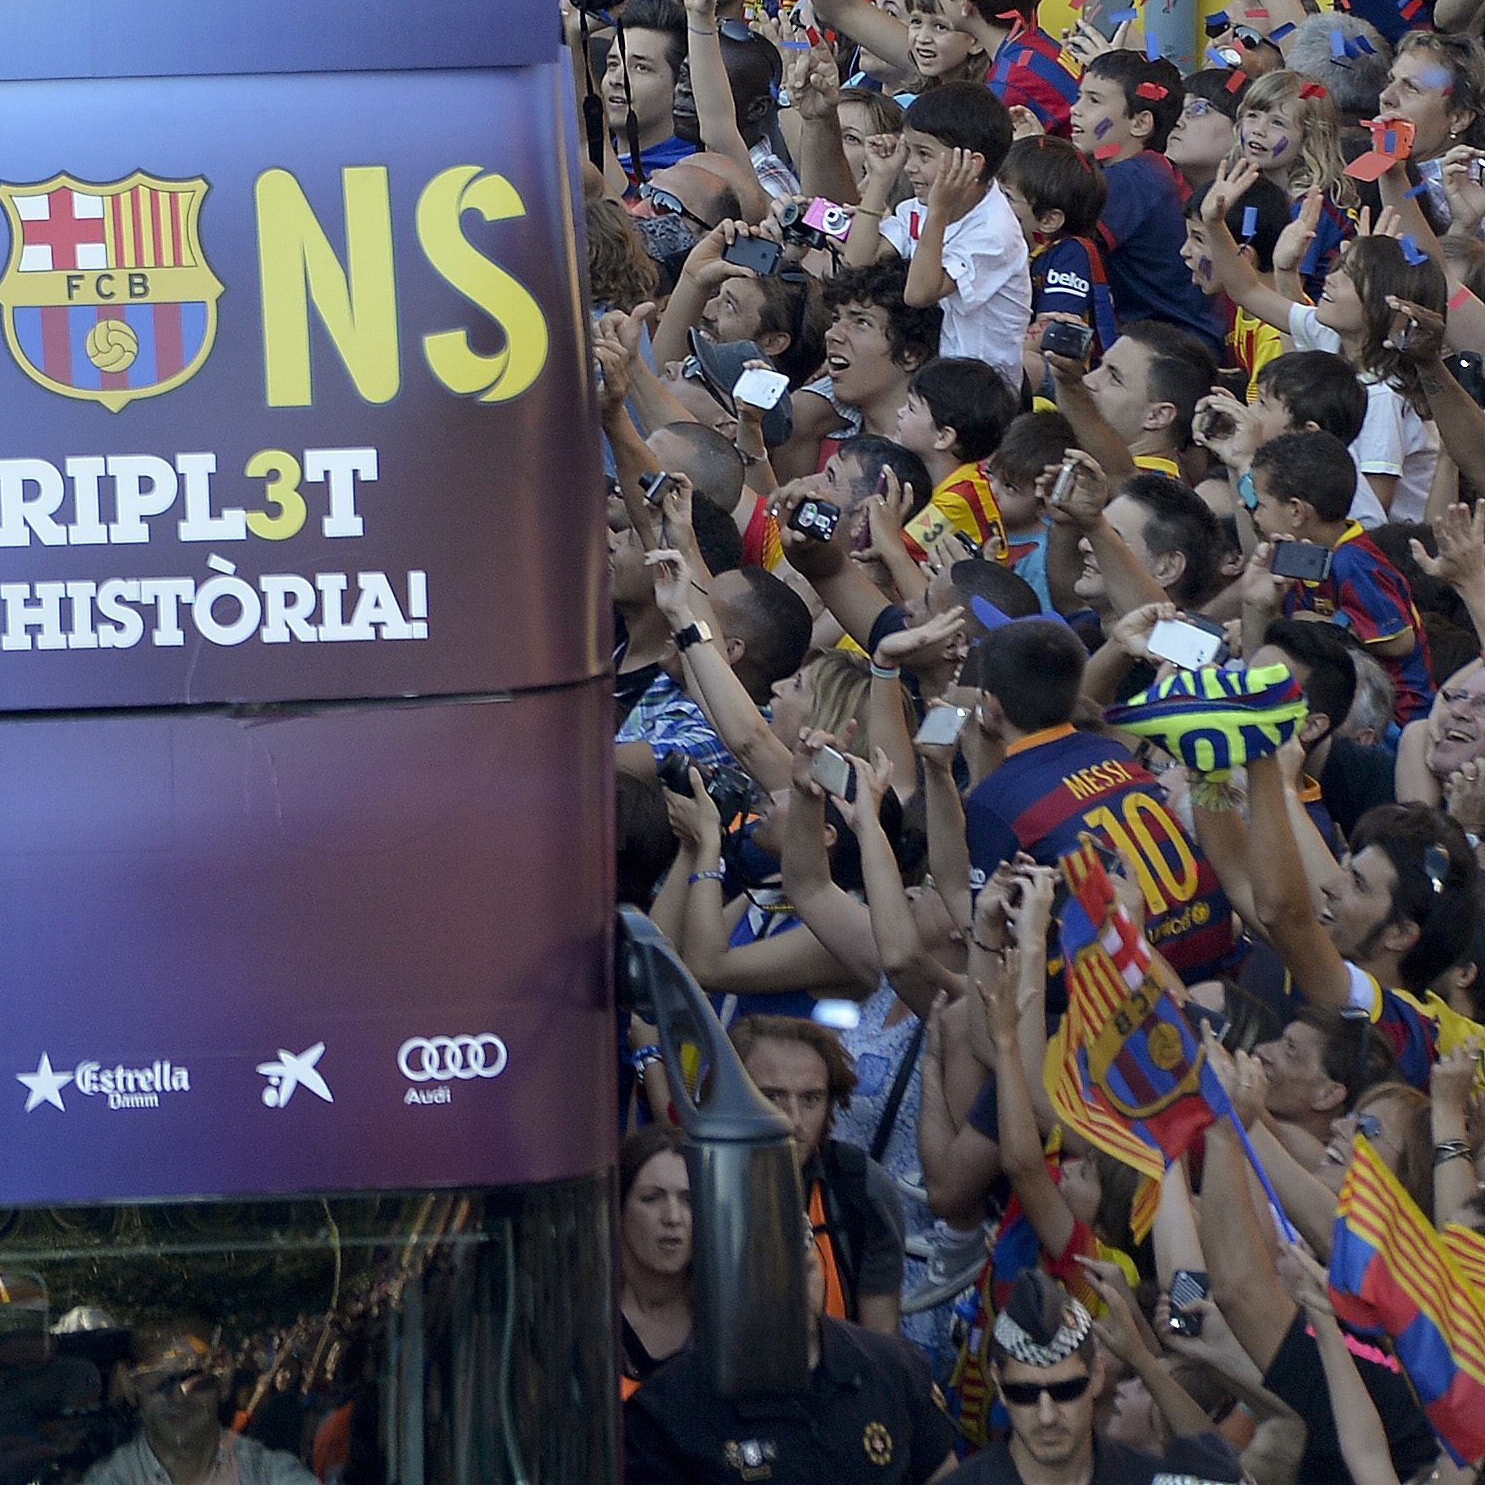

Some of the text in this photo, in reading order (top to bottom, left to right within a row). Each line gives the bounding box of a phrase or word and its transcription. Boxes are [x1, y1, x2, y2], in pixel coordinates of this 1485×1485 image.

[66, 272, 150, 301] FCB
[1046, 268, 1090, 293] beko
[1, 554, 429, 653] HISTÒRIA!
[1062, 759, 1132, 801] MESSI
[1082, 792, 1198, 915] 10
[74, 1061, 190, 1096] Estrella
[404, 1086, 452, 1105] Audi
